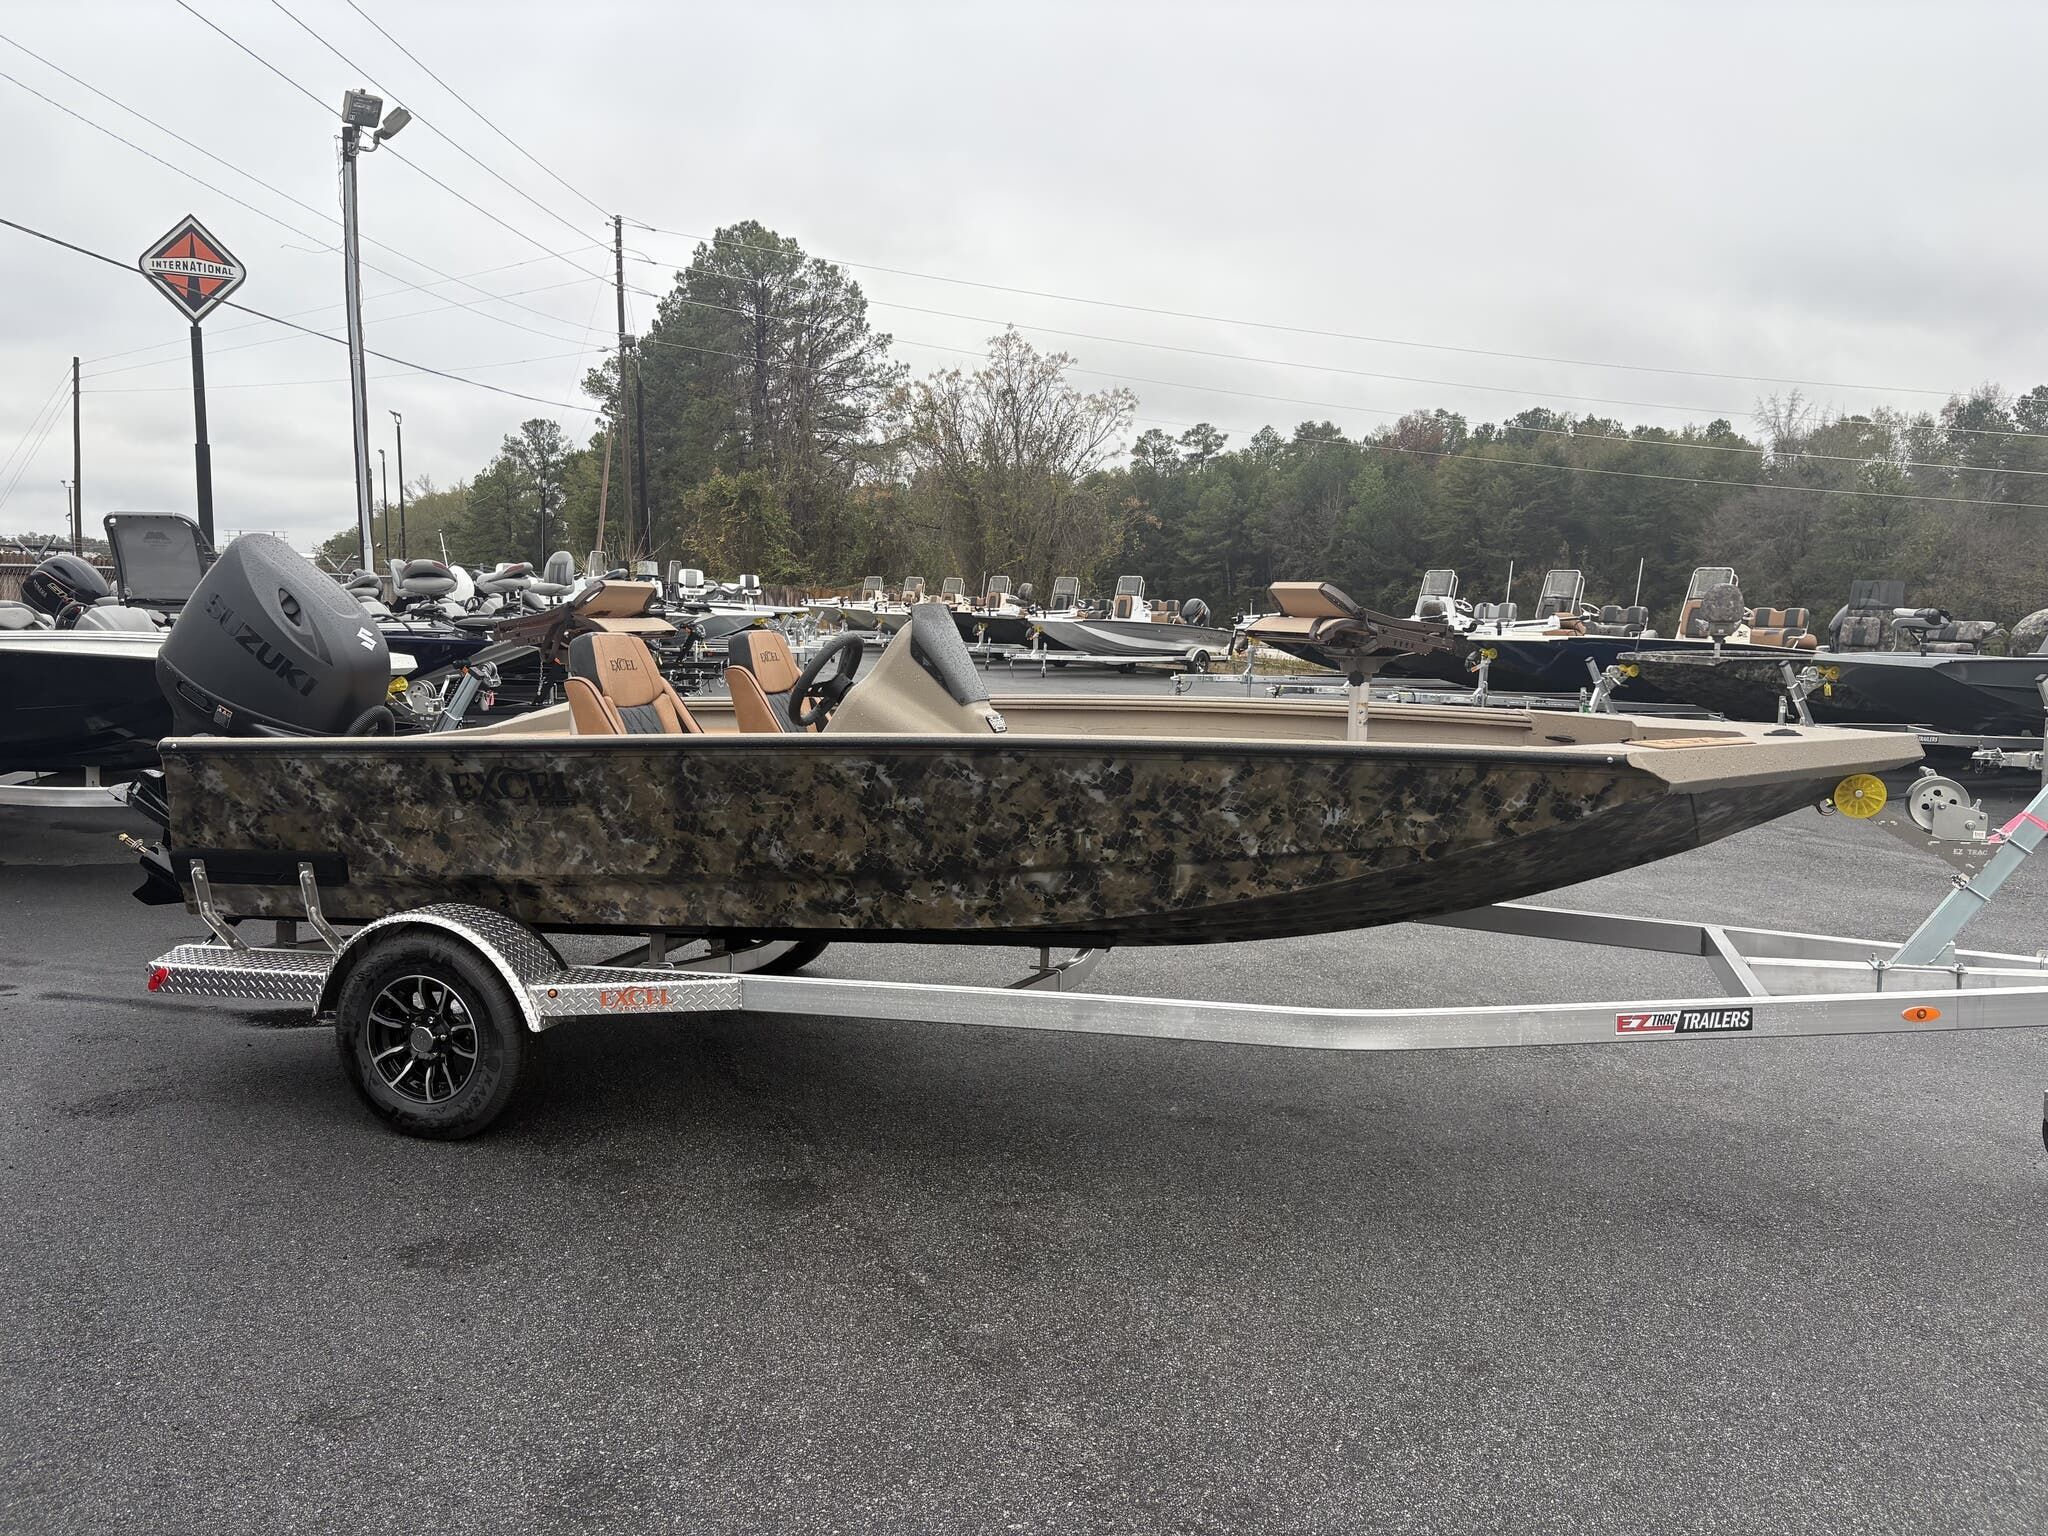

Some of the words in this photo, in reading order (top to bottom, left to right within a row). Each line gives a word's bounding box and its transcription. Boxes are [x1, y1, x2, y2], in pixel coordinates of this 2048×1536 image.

[151, 260, 235, 276] INTERNATIONAL
[205, 593, 318, 697] SUZUKI
[759, 650, 781, 663] EXCEL
[610, 657, 638, 672] EXCEL
[448, 766, 573, 802] EXCEL
[600, 986, 674, 1009] EXCEL
[1617, 1014, 1652, 1033] EZ
[1652, 1013, 1679, 1026] TRAC
[1683, 1010, 1750, 1030] TRAILERS
